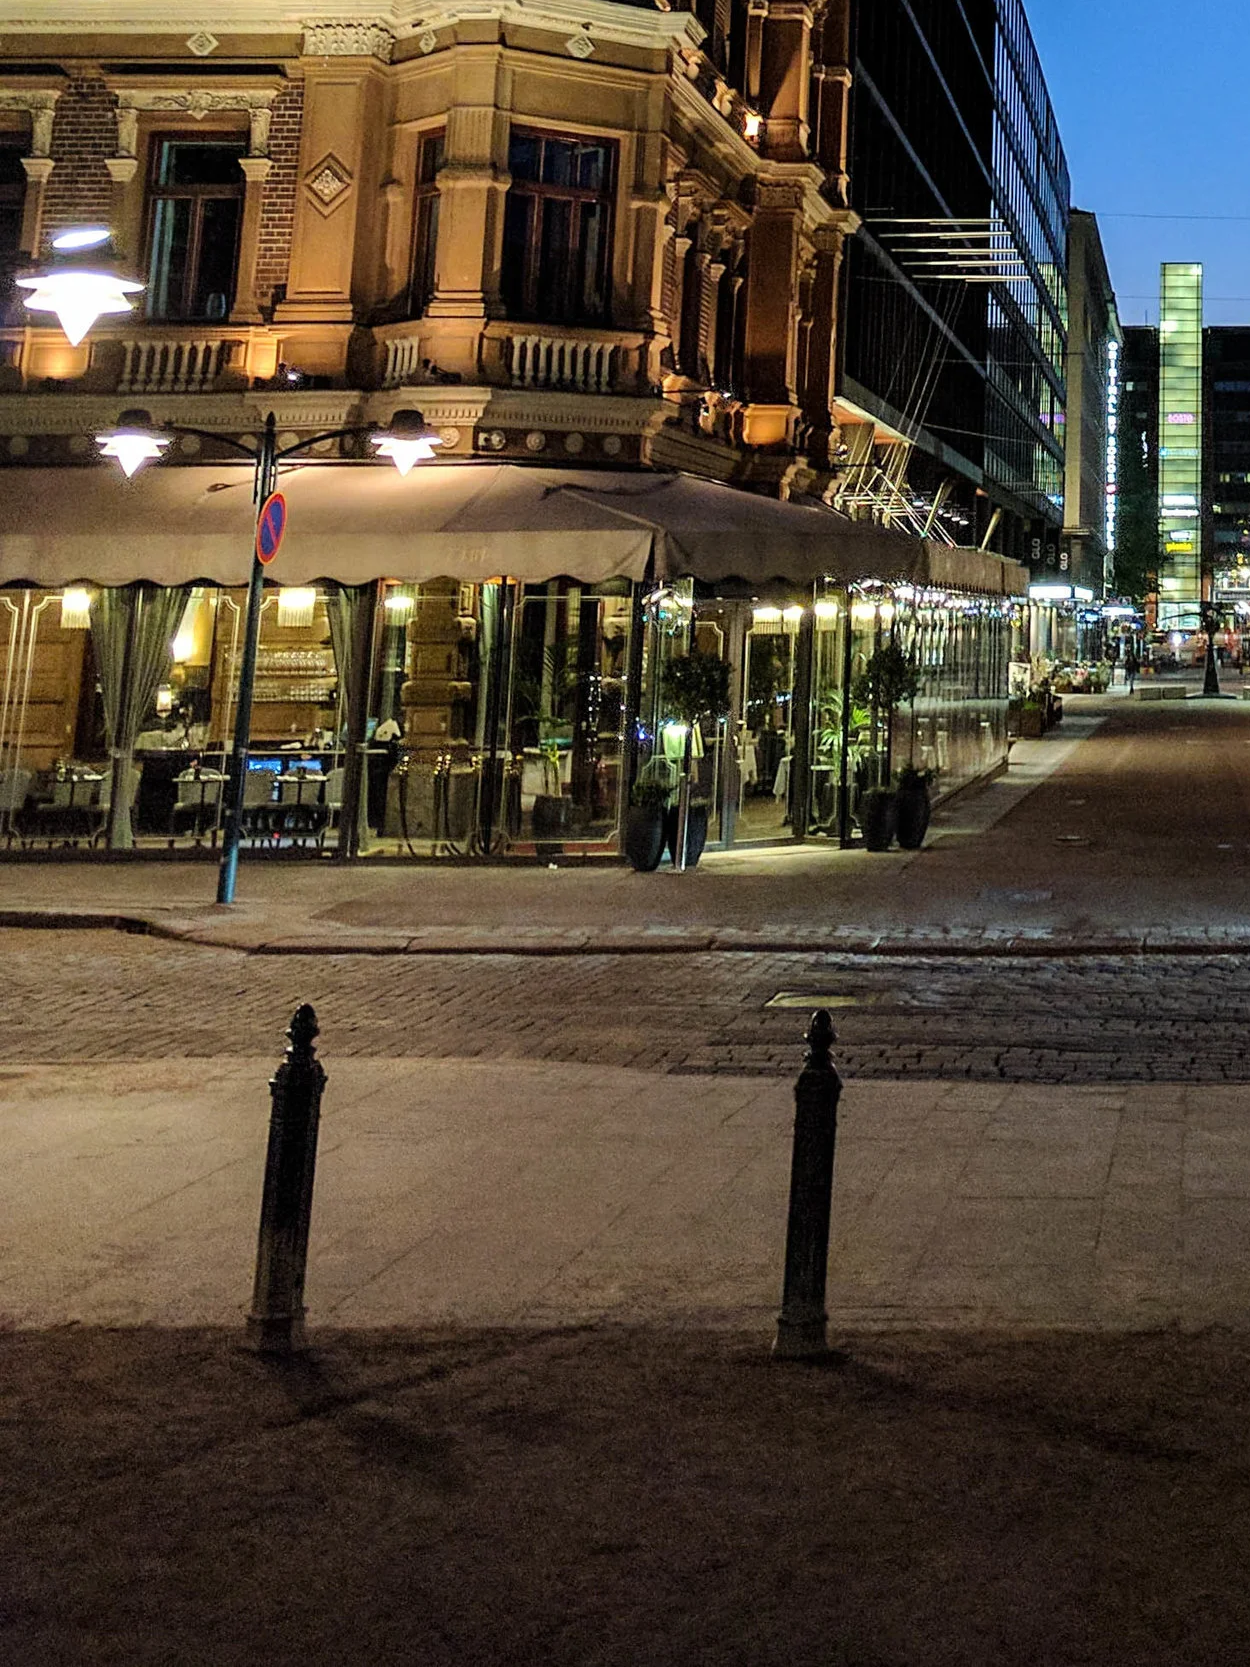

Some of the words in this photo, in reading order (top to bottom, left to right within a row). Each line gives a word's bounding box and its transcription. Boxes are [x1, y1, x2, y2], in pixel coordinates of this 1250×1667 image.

[1105, 494, 1116, 551] HOTELS
[1031, 538, 1041, 560] GLO
[1045, 543, 1056, 565] GLO
[1060, 552, 1068, 571] GLO
